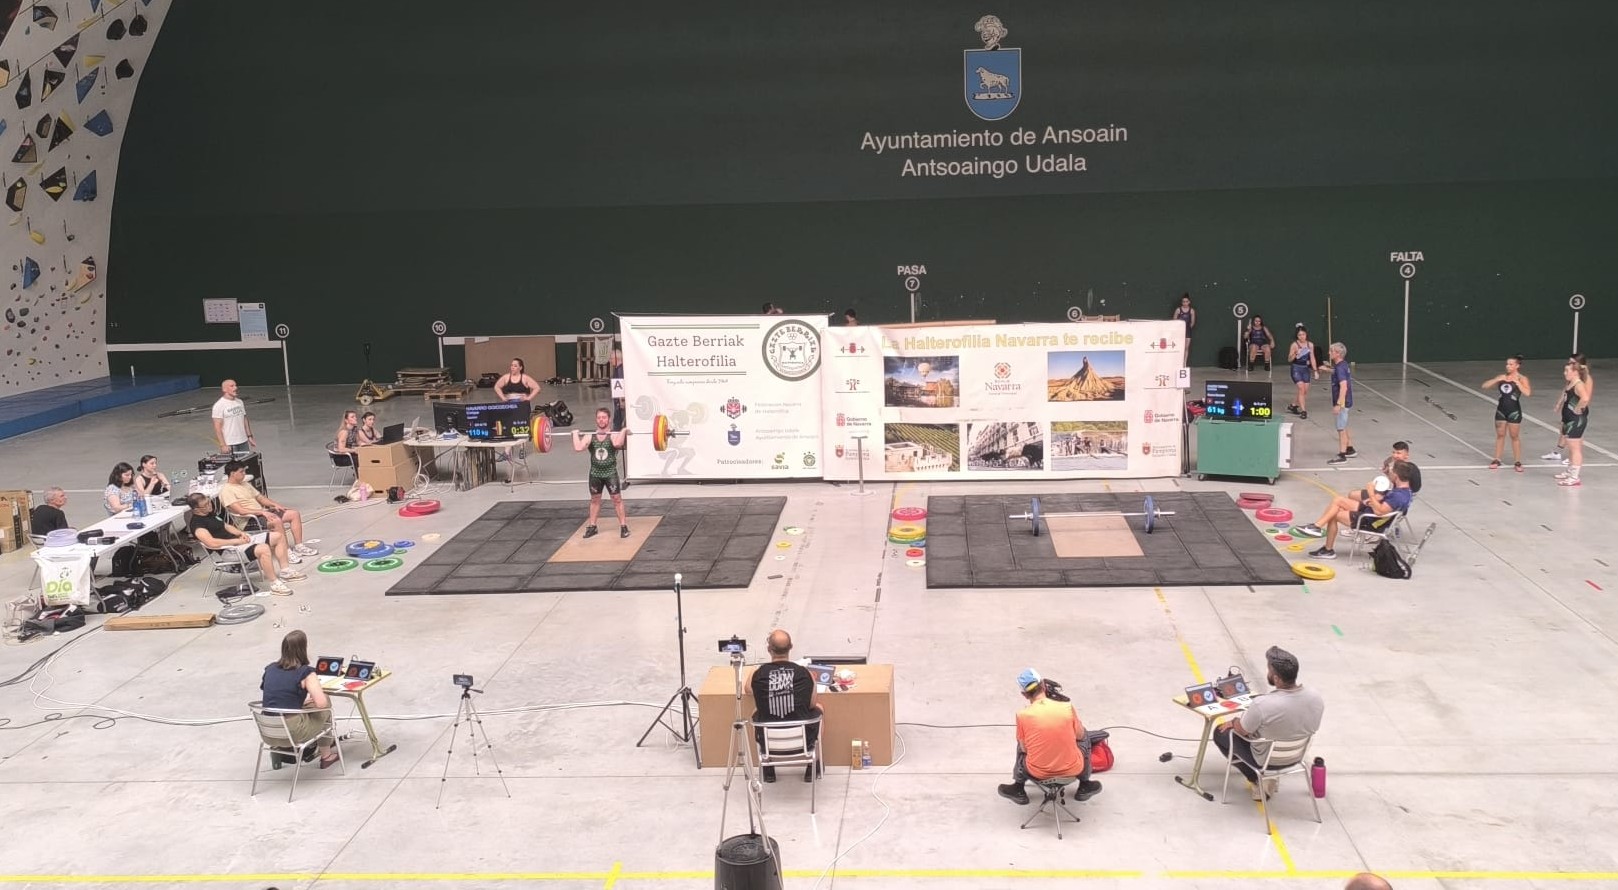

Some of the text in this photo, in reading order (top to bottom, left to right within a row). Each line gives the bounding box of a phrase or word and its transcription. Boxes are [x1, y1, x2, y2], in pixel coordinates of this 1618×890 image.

[860, 124, 1128, 154] Ayuntamiento de Ansoain
[901, 153, 1087, 179] Antsoaingo Udala
[1390, 251, 1424, 262] FALTA
[897, 265, 927, 276] PASA
[647, 334, 745, 347] Gazte Berriak
[881, 330, 1134, 350] La Halterofilia Navarra te recibe
[656, 354, 737, 367] Halterofilia
[1179, 370, 1187, 378] B
[613, 380, 623, 390] A
[984, 382, 1021, 391] Navarra
[1250, 407, 1271, 416] 1:00
[511, 426, 530, 435] 0:32
[769, 671, 794, 681] SHOW
